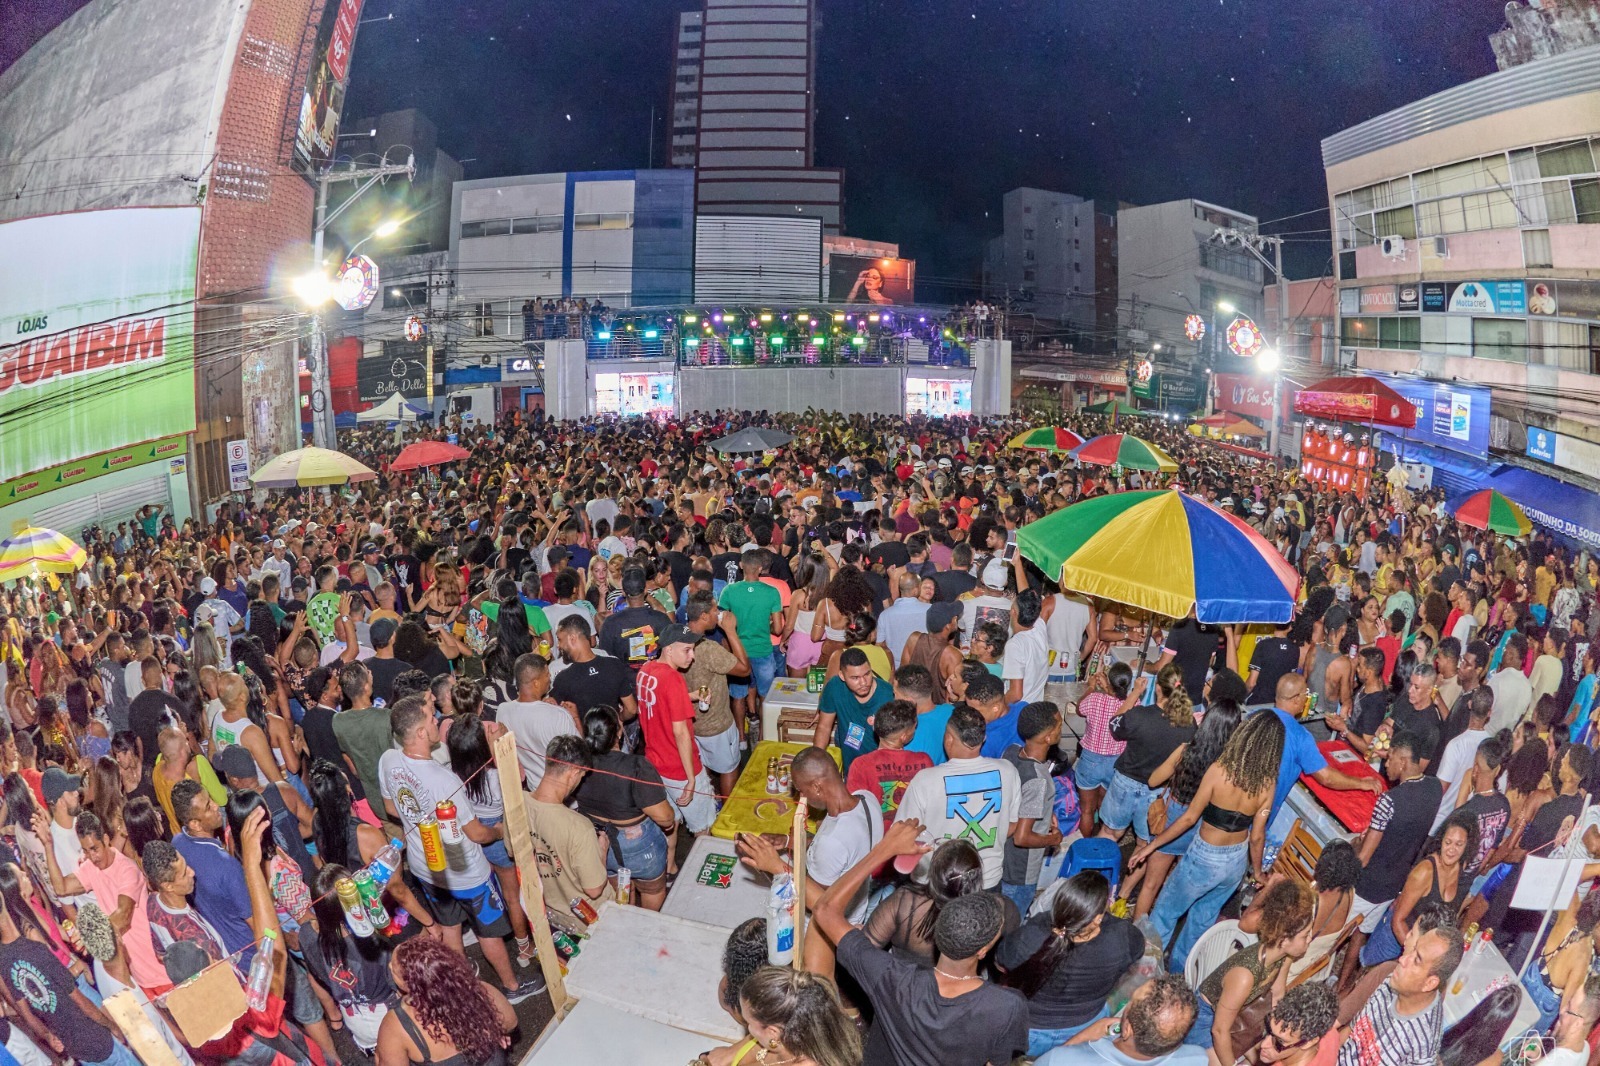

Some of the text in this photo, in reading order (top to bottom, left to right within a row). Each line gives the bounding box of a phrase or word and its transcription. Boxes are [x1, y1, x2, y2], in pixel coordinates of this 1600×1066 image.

[1360, 292, 1397, 305] ADVOCACIA
[17, 316, 48, 334] LOJAS
[0, 317, 164, 392] GUAIBIM
[375, 381, 399, 395] Bella
[1247, 388, 1260, 403] Boa
[234, 448, 240, 458] E
[1530, 447, 1551, 459] Loterias
[1515, 502, 1563, 529] RIQUITINHO
[1566, 521, 1577, 534] DA
[422, 830, 439, 864] DEVASSA
